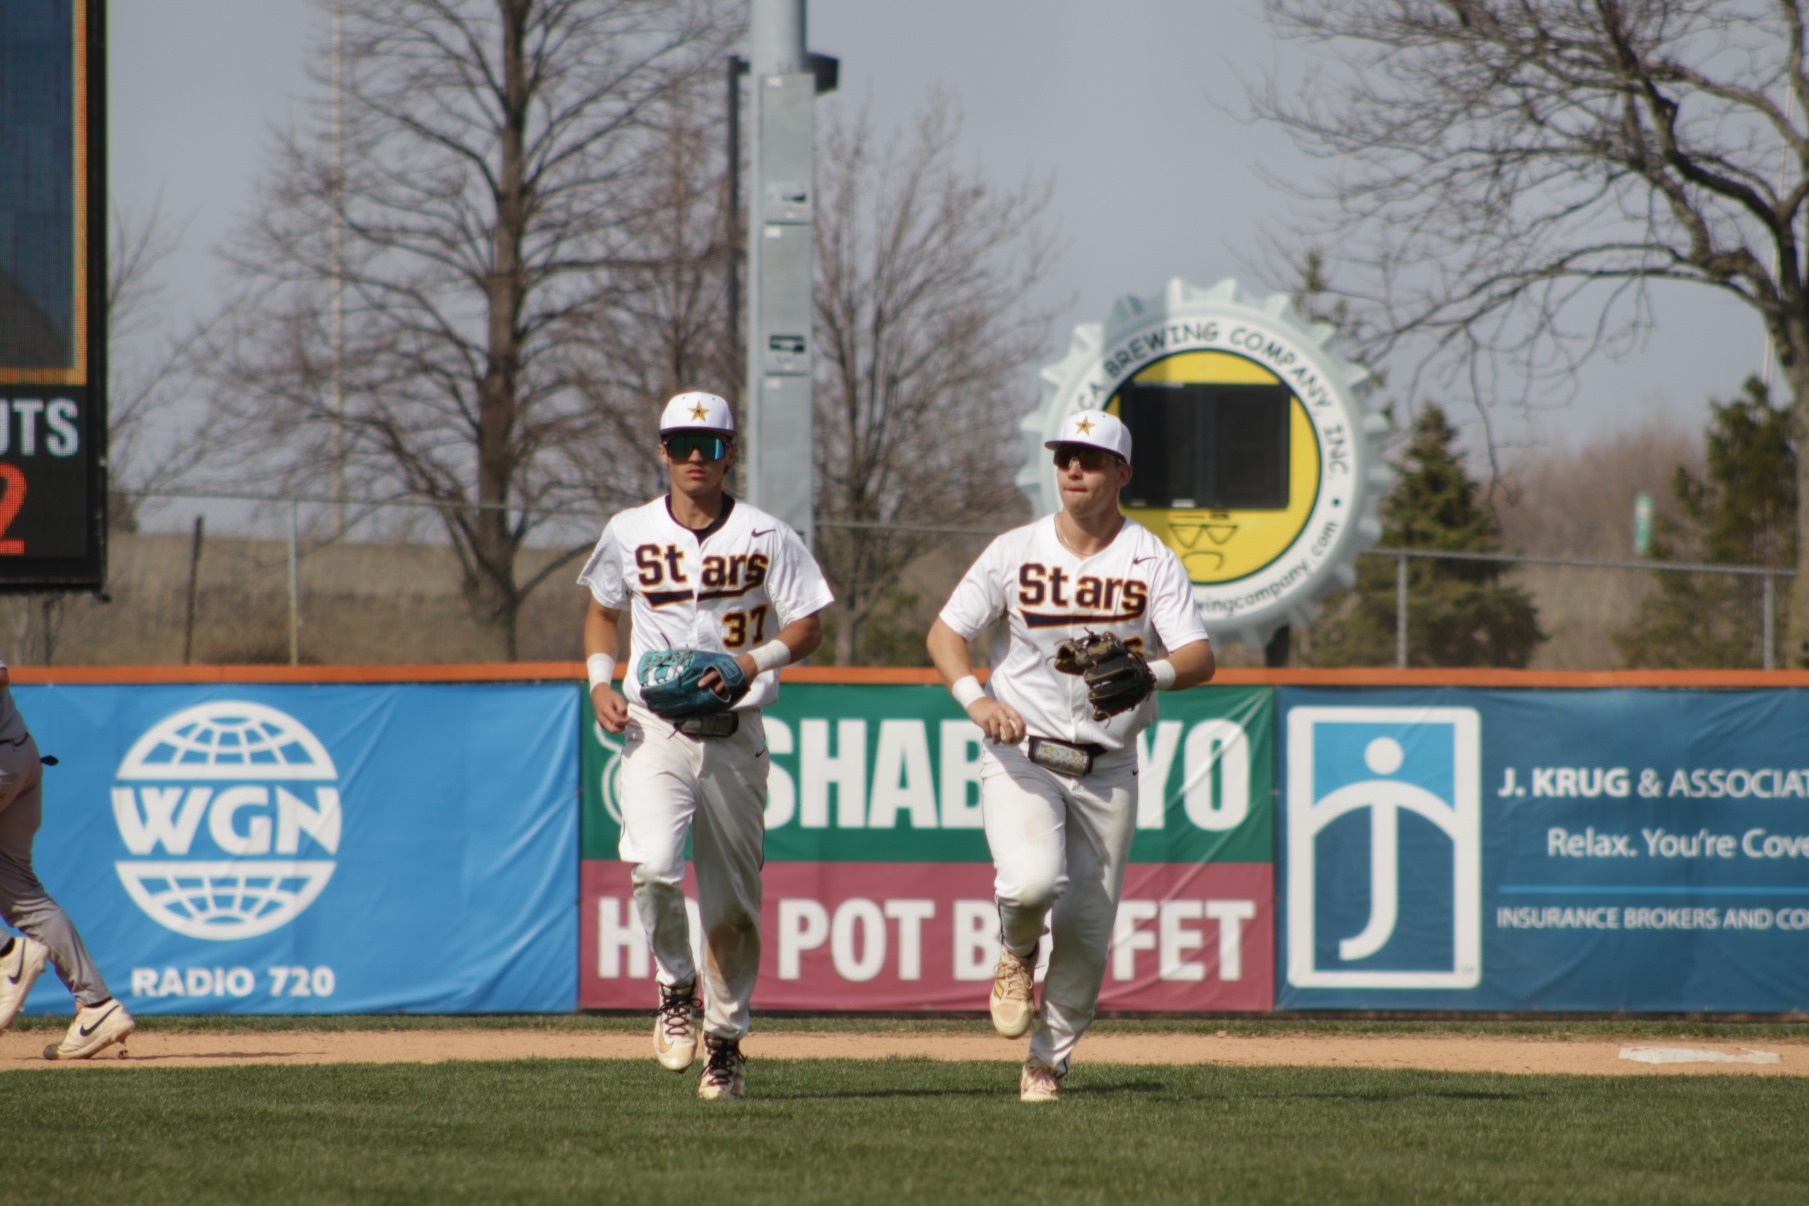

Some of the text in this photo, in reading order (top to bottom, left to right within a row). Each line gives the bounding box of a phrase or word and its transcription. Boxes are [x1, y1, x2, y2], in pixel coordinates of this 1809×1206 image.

[1103, 322, 1218, 378] BREWING
[635, 543, 768, 588] Stars
[1018, 562, 1147, 615] Stars
[722, 603, 768, 650] 37
[763, 716, 985, 831] SHAB
[1497, 767, 1526, 797] J.
[1532, 767, 1630, 798] KRUG
[1637, 768, 1664, 798] &
[111, 785, 342, 855] WGN
[1547, 826, 1638, 858] Relax.
[778, 898, 935, 982] POT
[953, 899, 1257, 982] BFET
[1497, 906, 1809, 931] INSURANCE BROKERS AND CO
[131, 967, 336, 997] RADIO 720
